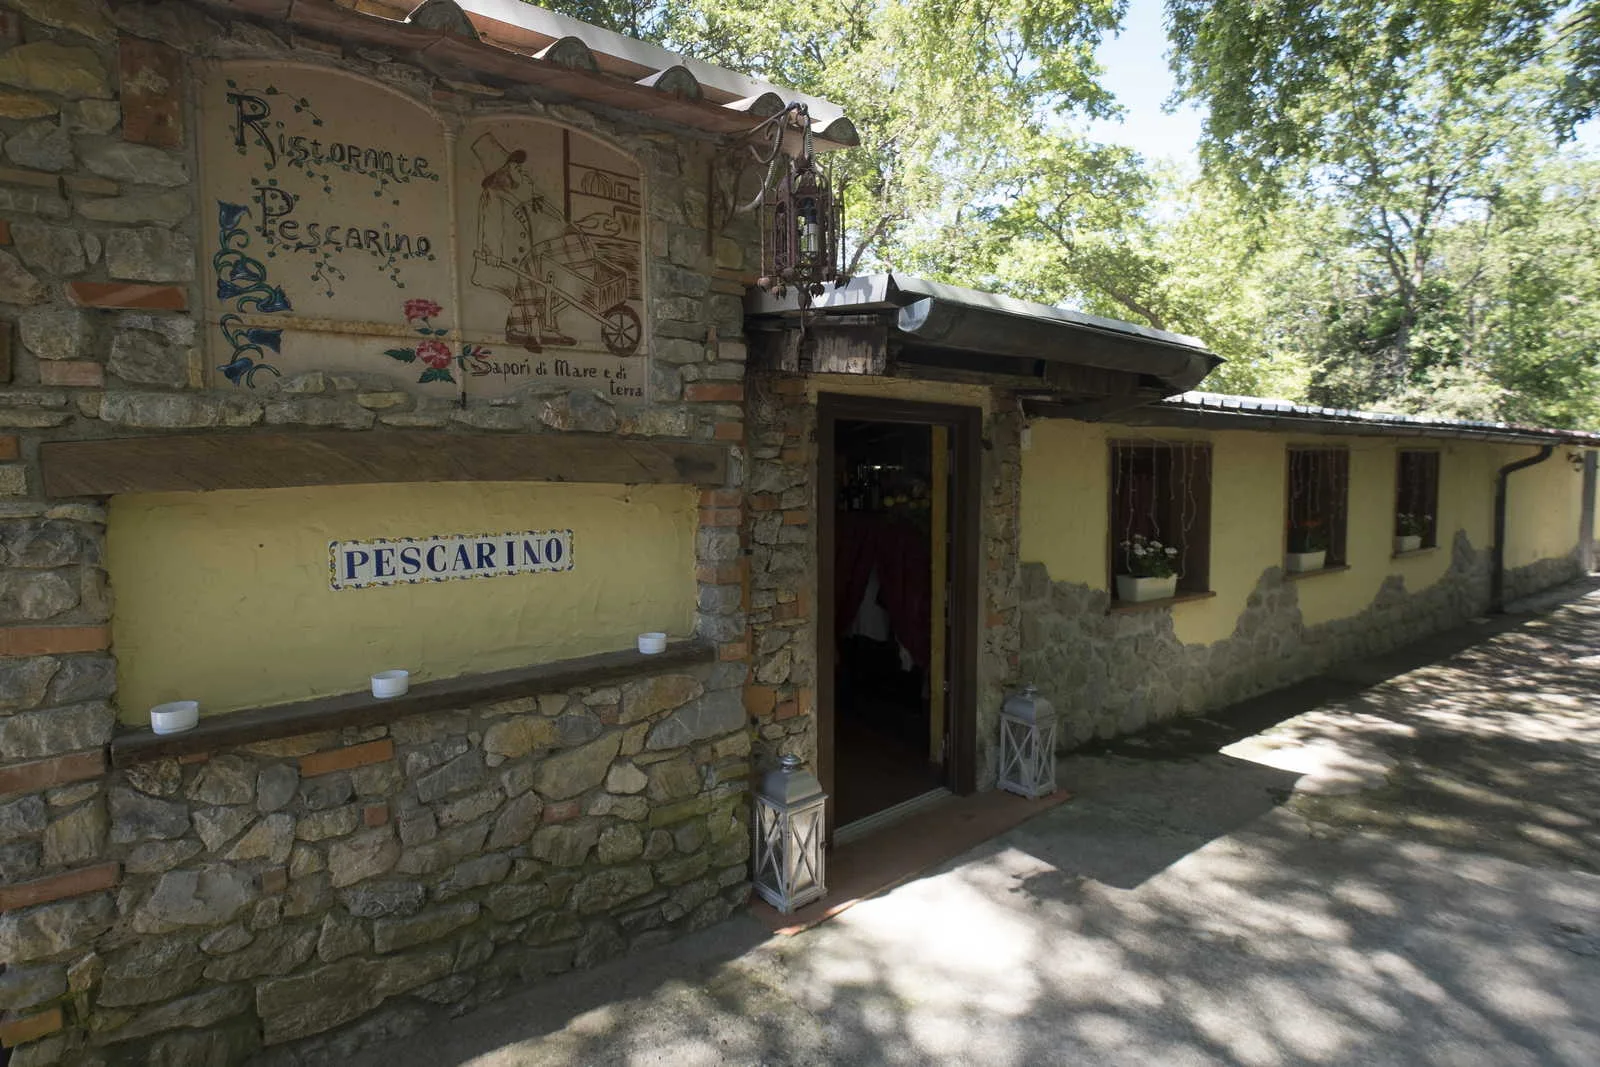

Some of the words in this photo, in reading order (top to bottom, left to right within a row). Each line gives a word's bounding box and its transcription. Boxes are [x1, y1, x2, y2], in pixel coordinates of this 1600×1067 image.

[471, 357, 530, 384] Sapori
[535, 361, 548, 376] di
[554, 359, 598, 379] Mare
[603, 369, 612, 379] e
[615, 364, 628, 380] di
[609, 379, 644, 397] terra
[343, 537, 564, 580] PESCARINO
